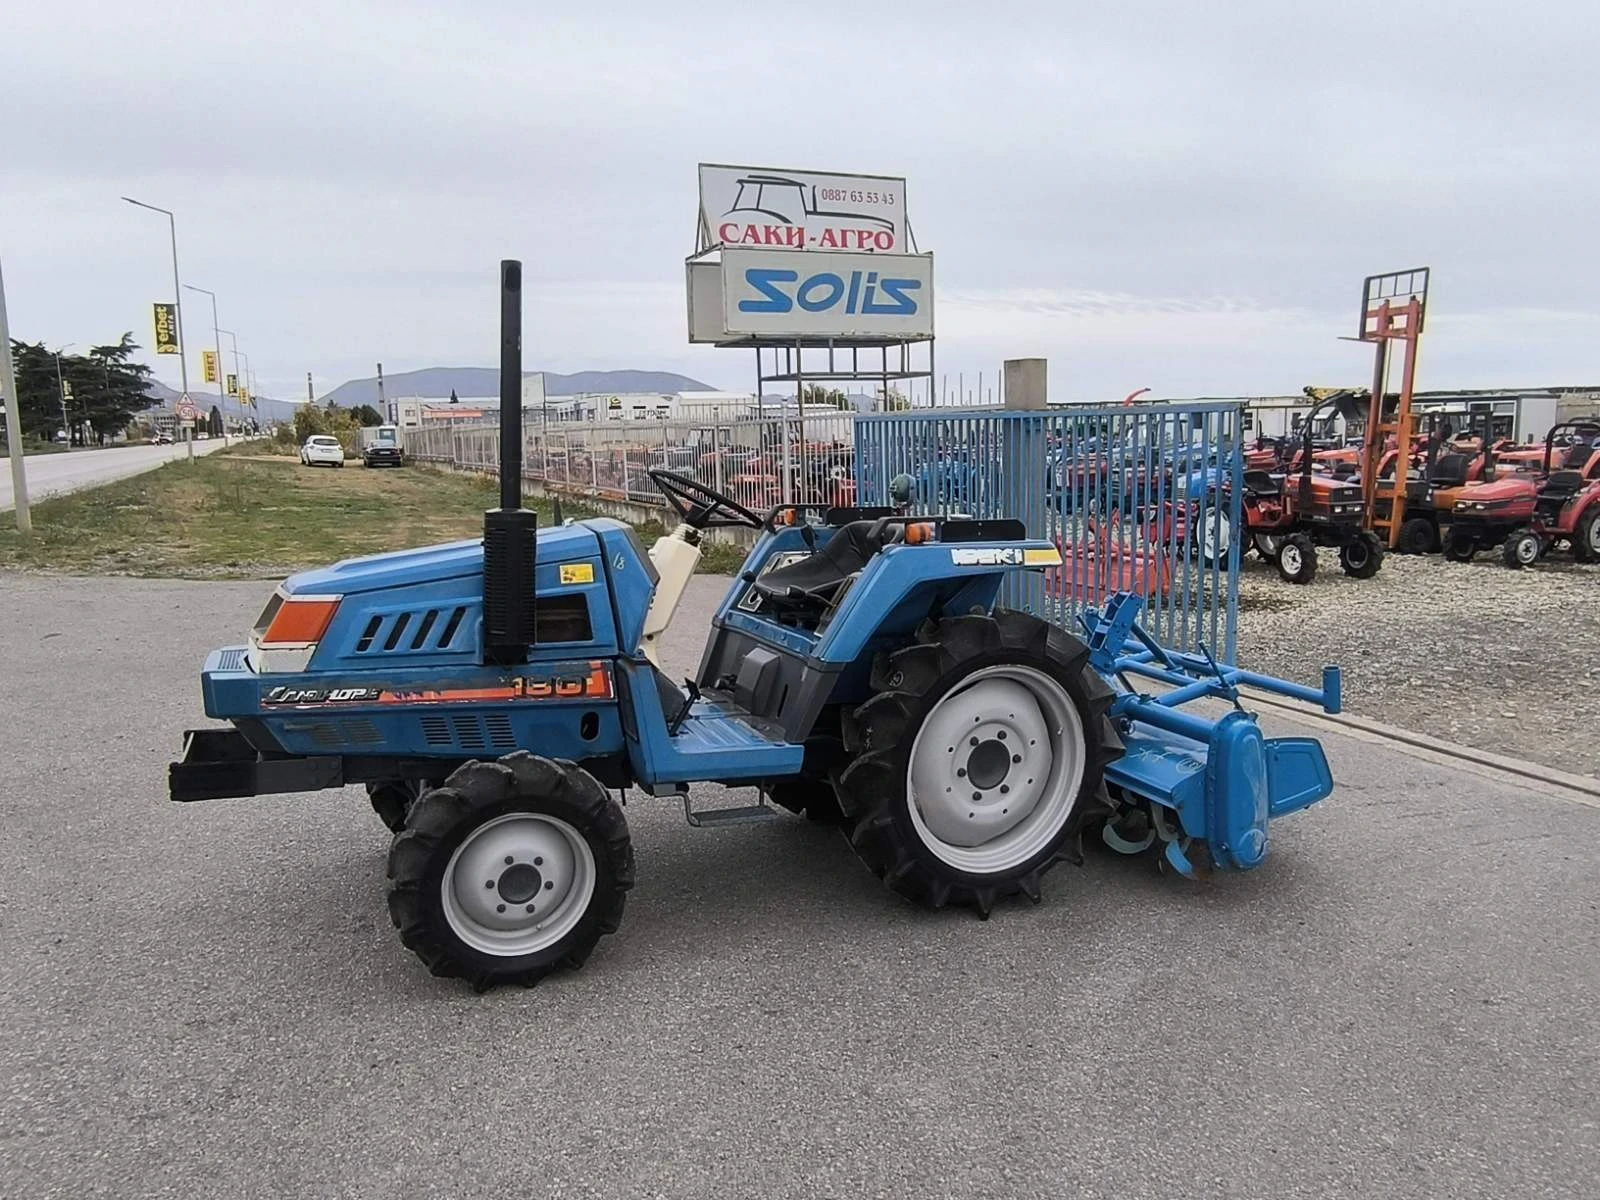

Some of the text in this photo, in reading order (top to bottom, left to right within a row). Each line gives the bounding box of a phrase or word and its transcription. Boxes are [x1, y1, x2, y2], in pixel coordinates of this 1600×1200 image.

[821, 188, 895, 206] 0887 63 53 43
[719, 222, 895, 250] САКИ-АГРО
